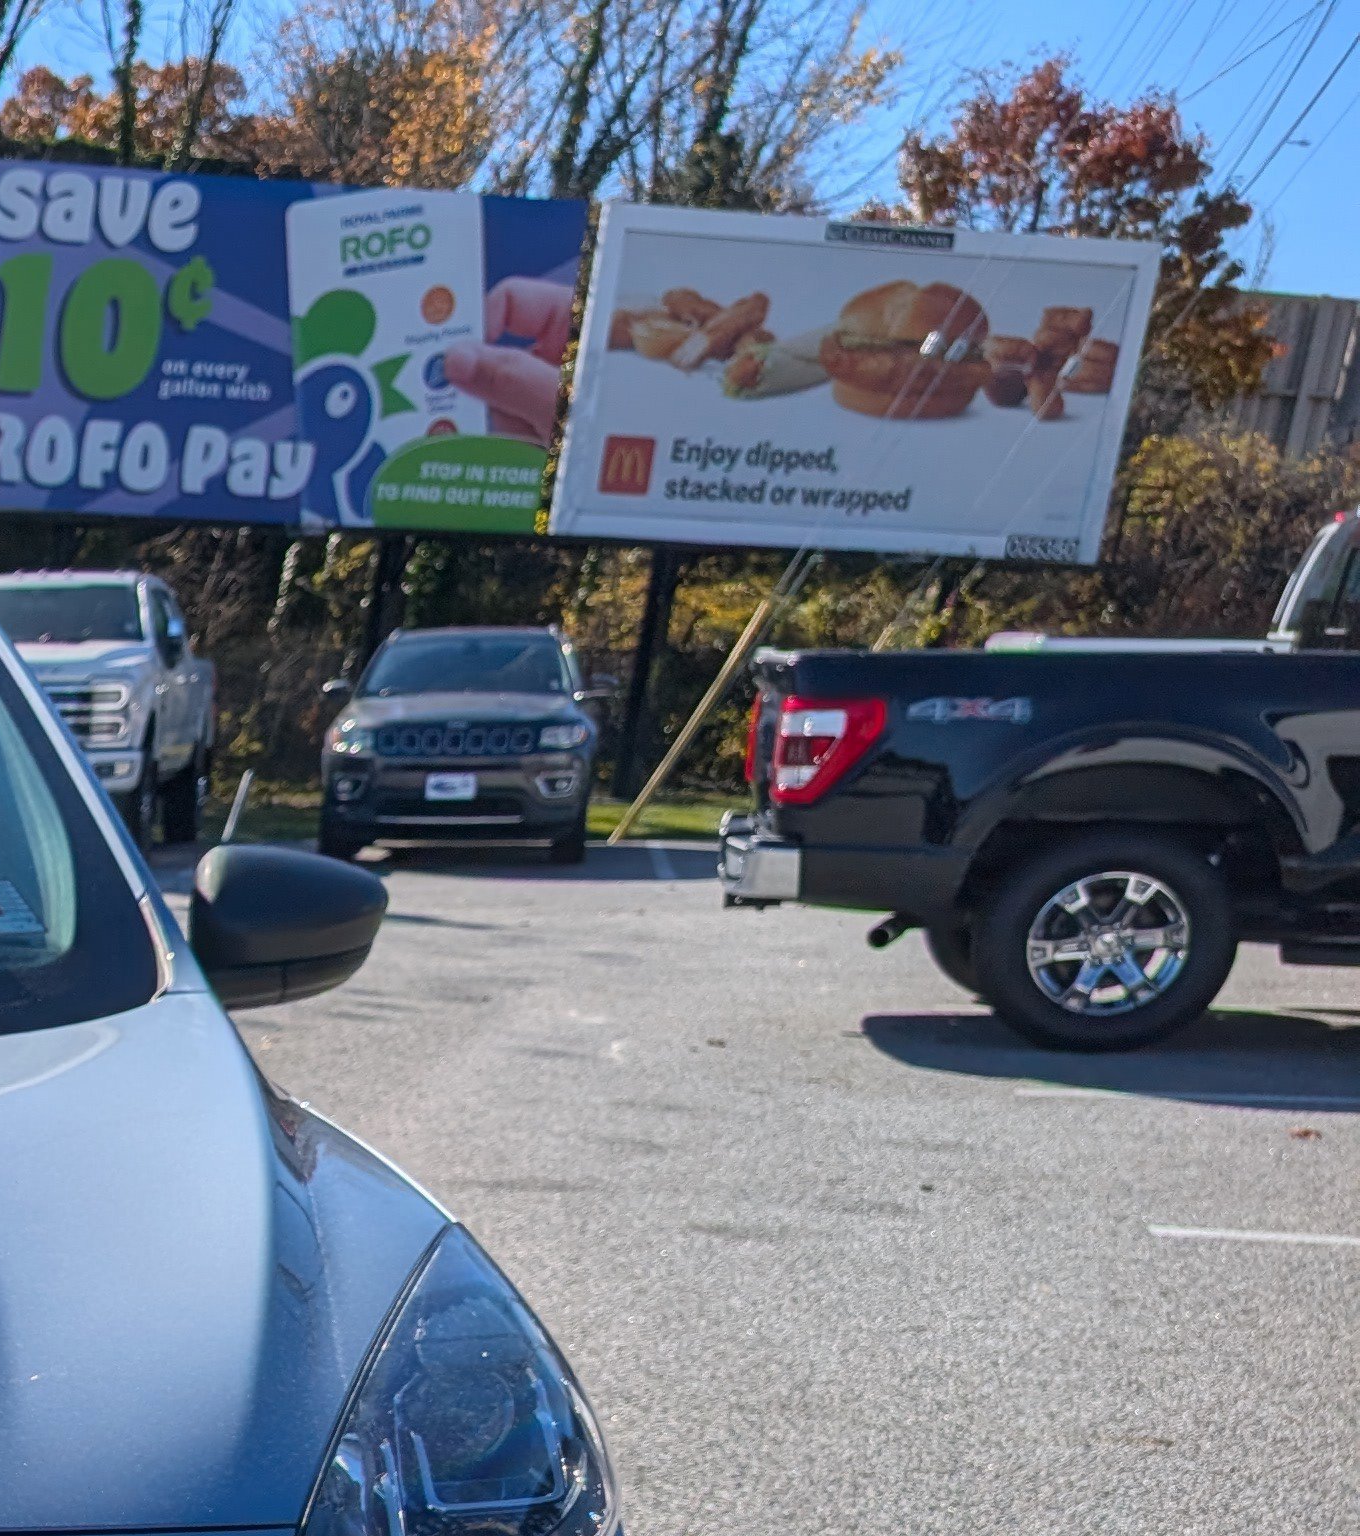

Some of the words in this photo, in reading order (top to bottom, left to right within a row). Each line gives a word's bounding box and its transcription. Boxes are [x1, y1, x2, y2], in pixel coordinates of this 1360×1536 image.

[339, 223, 433, 264] ROFO
[162, 358, 188, 376] on
[191, 359, 249, 384] every
[158, 378, 221, 400] gallon
[181, 424, 316, 500] Pay
[670, 436, 742, 472] Enjoy
[744, 439, 839, 475] dipped,
[420, 460, 462, 480] STOP
[464, 464, 484, 481] IN
[488, 466, 539, 485] STORE
[377, 483, 400, 501] TO
[400, 483, 442, 503] FIND
[445, 486, 481, 505] OUT
[663, 476, 767, 503] stacked
[769, 484, 798, 505] or
[800, 485, 912, 516] wrapped
